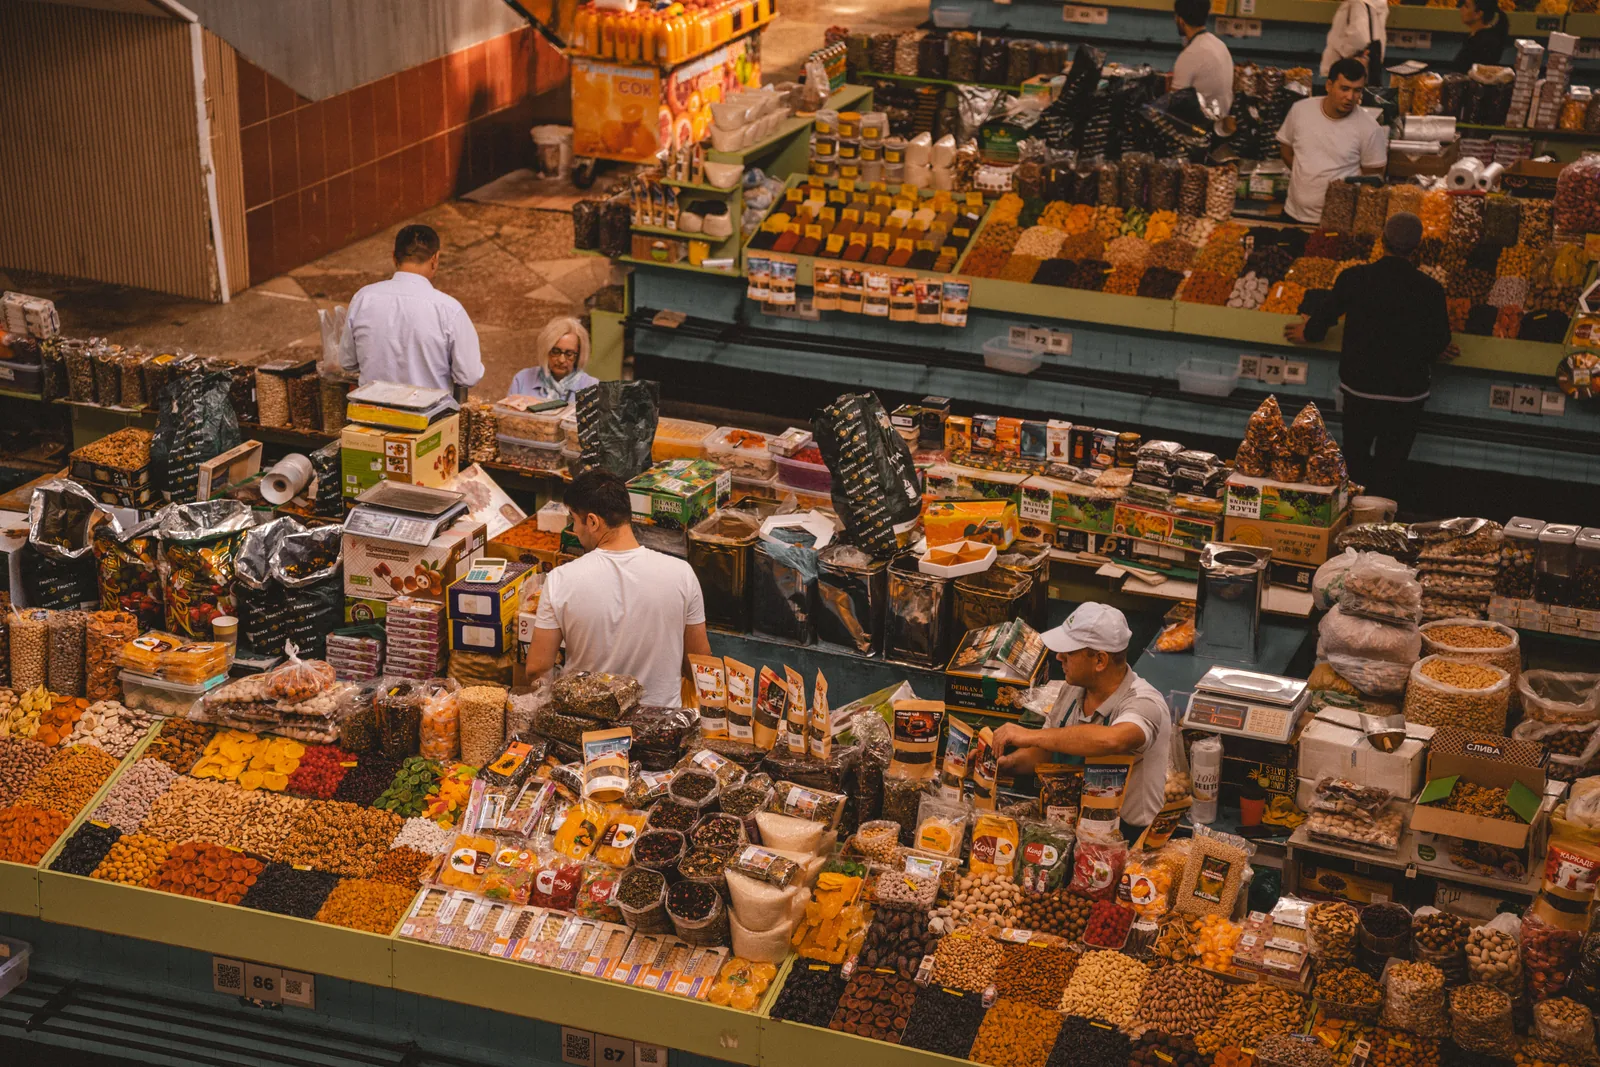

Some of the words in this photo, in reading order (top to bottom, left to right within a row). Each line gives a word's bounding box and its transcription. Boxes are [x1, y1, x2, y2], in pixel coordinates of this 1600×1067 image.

[1034, 335, 1046, 345] 72
[1267, 365, 1280, 375] 73
[1520, 396, 1534, 406] 74
[654, 499, 682, 508] BLACK
[654, 505, 683, 513] RAISINS
[1023, 506, 1049, 516] BLACK
[1229, 504, 1258, 514] BLACK
[1466, 743, 1500, 755] СЛИВА
[1265, 765, 1287, 777] DATES
[1560, 851, 1594, 868] КАРКАДЕ
[1235, 958, 1264, 969] Barakat
[253, 975, 274, 991] 86
[603, 1047, 625, 1062] 87
